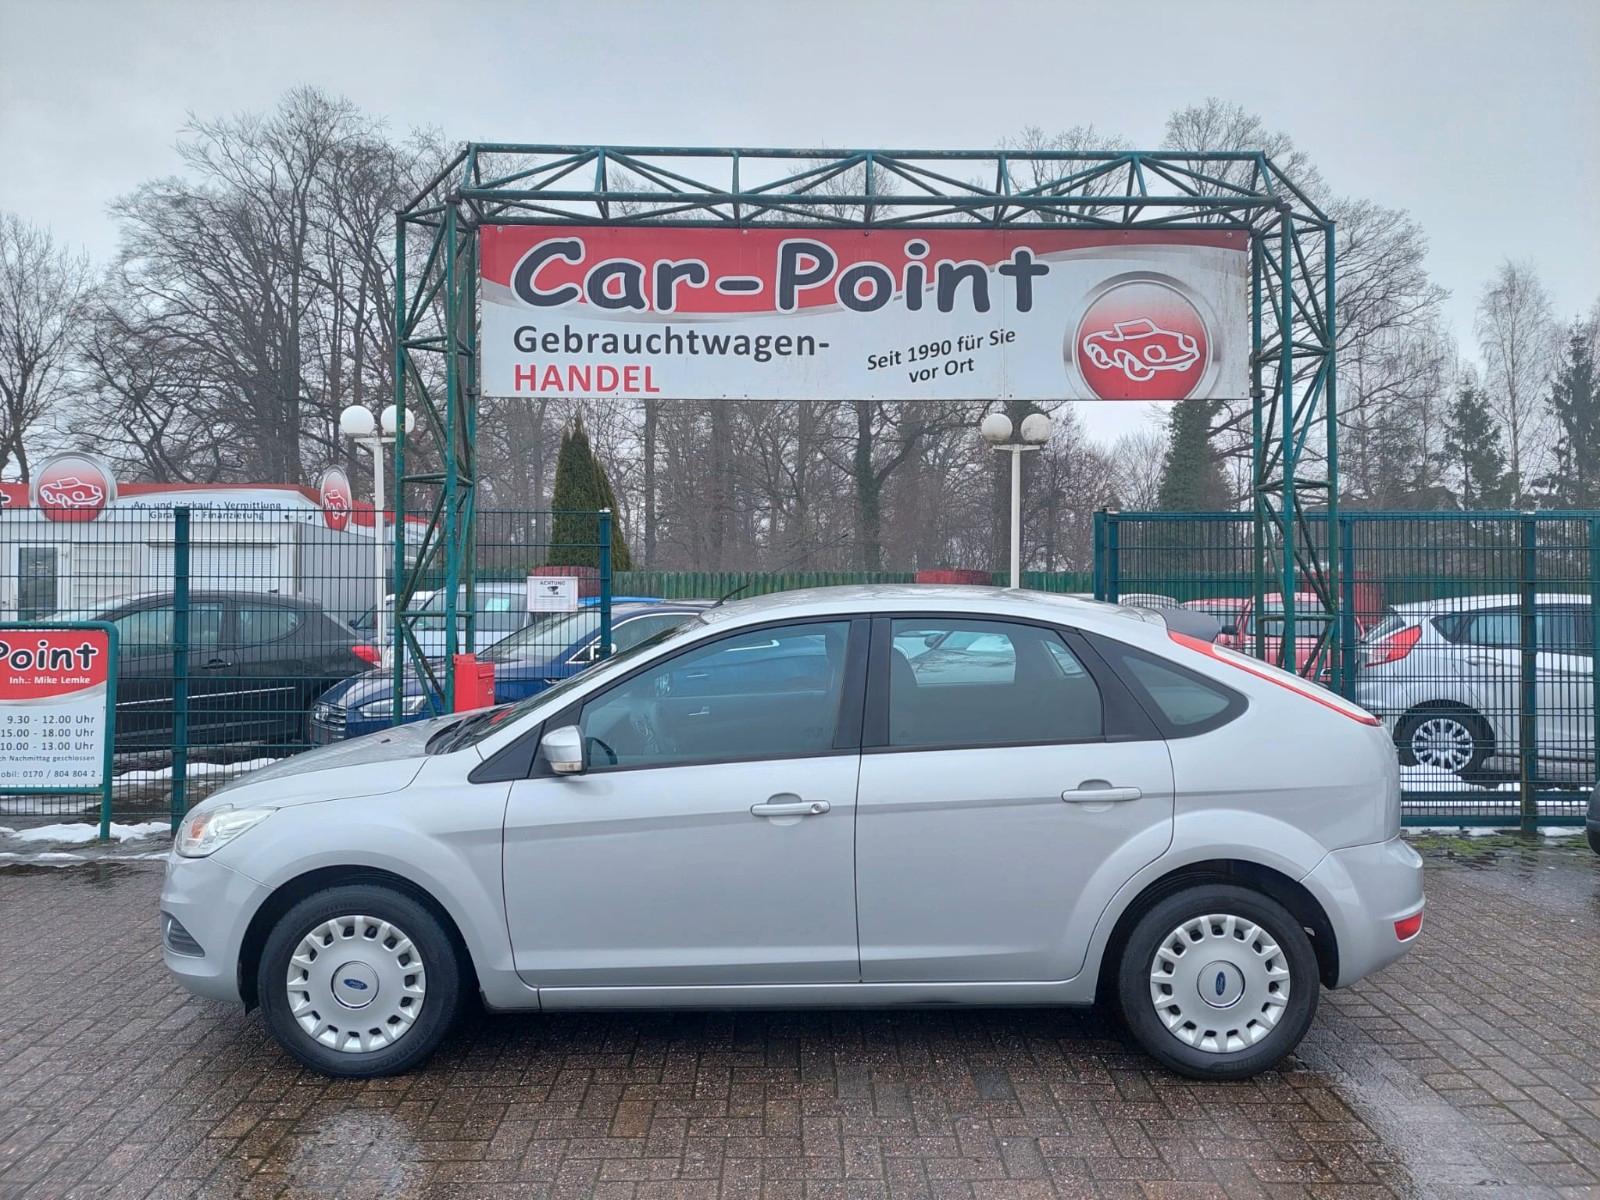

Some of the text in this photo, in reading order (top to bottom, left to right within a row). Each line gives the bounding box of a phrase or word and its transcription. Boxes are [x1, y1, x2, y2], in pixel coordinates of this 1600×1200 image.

[511, 237, 1050, 314] Car-Point
[513, 324, 830, 363] Gebrauchtwagen-
[867, 329, 1016, 370] Seit 1990 für Sie
[908, 357, 975, 383] vor Ort
[514, 364, 660, 393] HANDEL
[224, 501, 281, 511] Vermittlung
[203, 511, 264, 521] Finanzierung
[34, 676, 57, 685] Mike
[61, 676, 91, 685] Lemke
[7, 715, 30, 724] 9.30
[42, 715, 72, 724] 12.00
[75, 715, 95, 724] Uhr
[1, 728, 30, 738] 15.00
[42, 728, 71, 738] 18.00
[75, 728, 95, 737] Uhr
[0, 742, 29, 751] 10.00
[42, 742, 71, 751] 13.00
[75, 741, 94, 750] Uhr
[9, 755, 51, 763] Nachmittag
[53, 755, 95, 763] geschlossen
[23, 770, 44, 778] 0170
[54, 770, 69, 778] 804
[72, 769, 88, 778] 804
